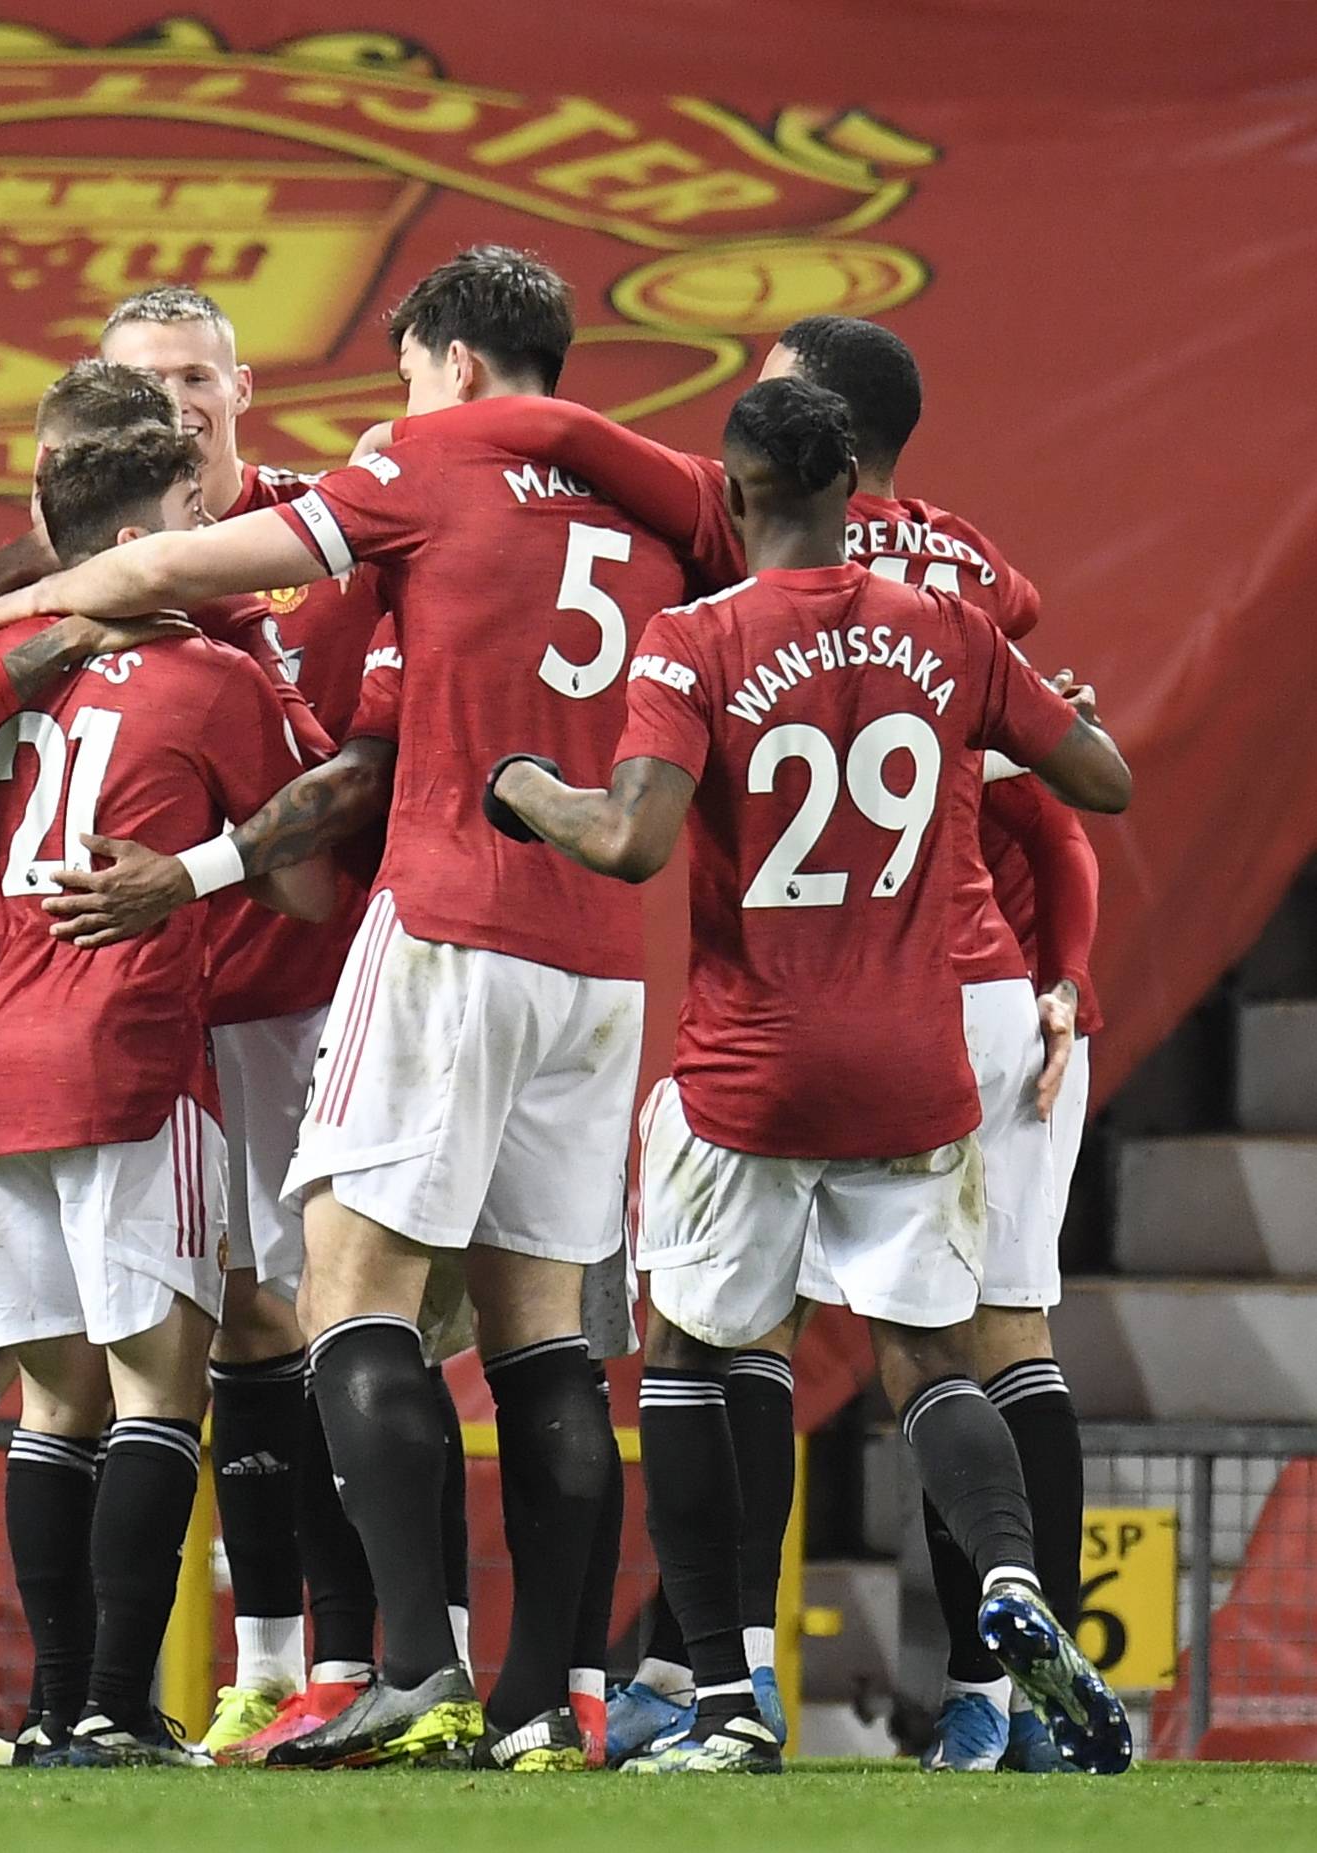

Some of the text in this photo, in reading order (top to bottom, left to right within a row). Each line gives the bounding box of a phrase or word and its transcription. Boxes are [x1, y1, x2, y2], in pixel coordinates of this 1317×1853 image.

[538, 521, 632, 699] 5
[726, 625, 955, 727] WAN-BISSAKA
[742, 713, 941, 908] 29
[1076, 1569, 1127, 1672] 6
